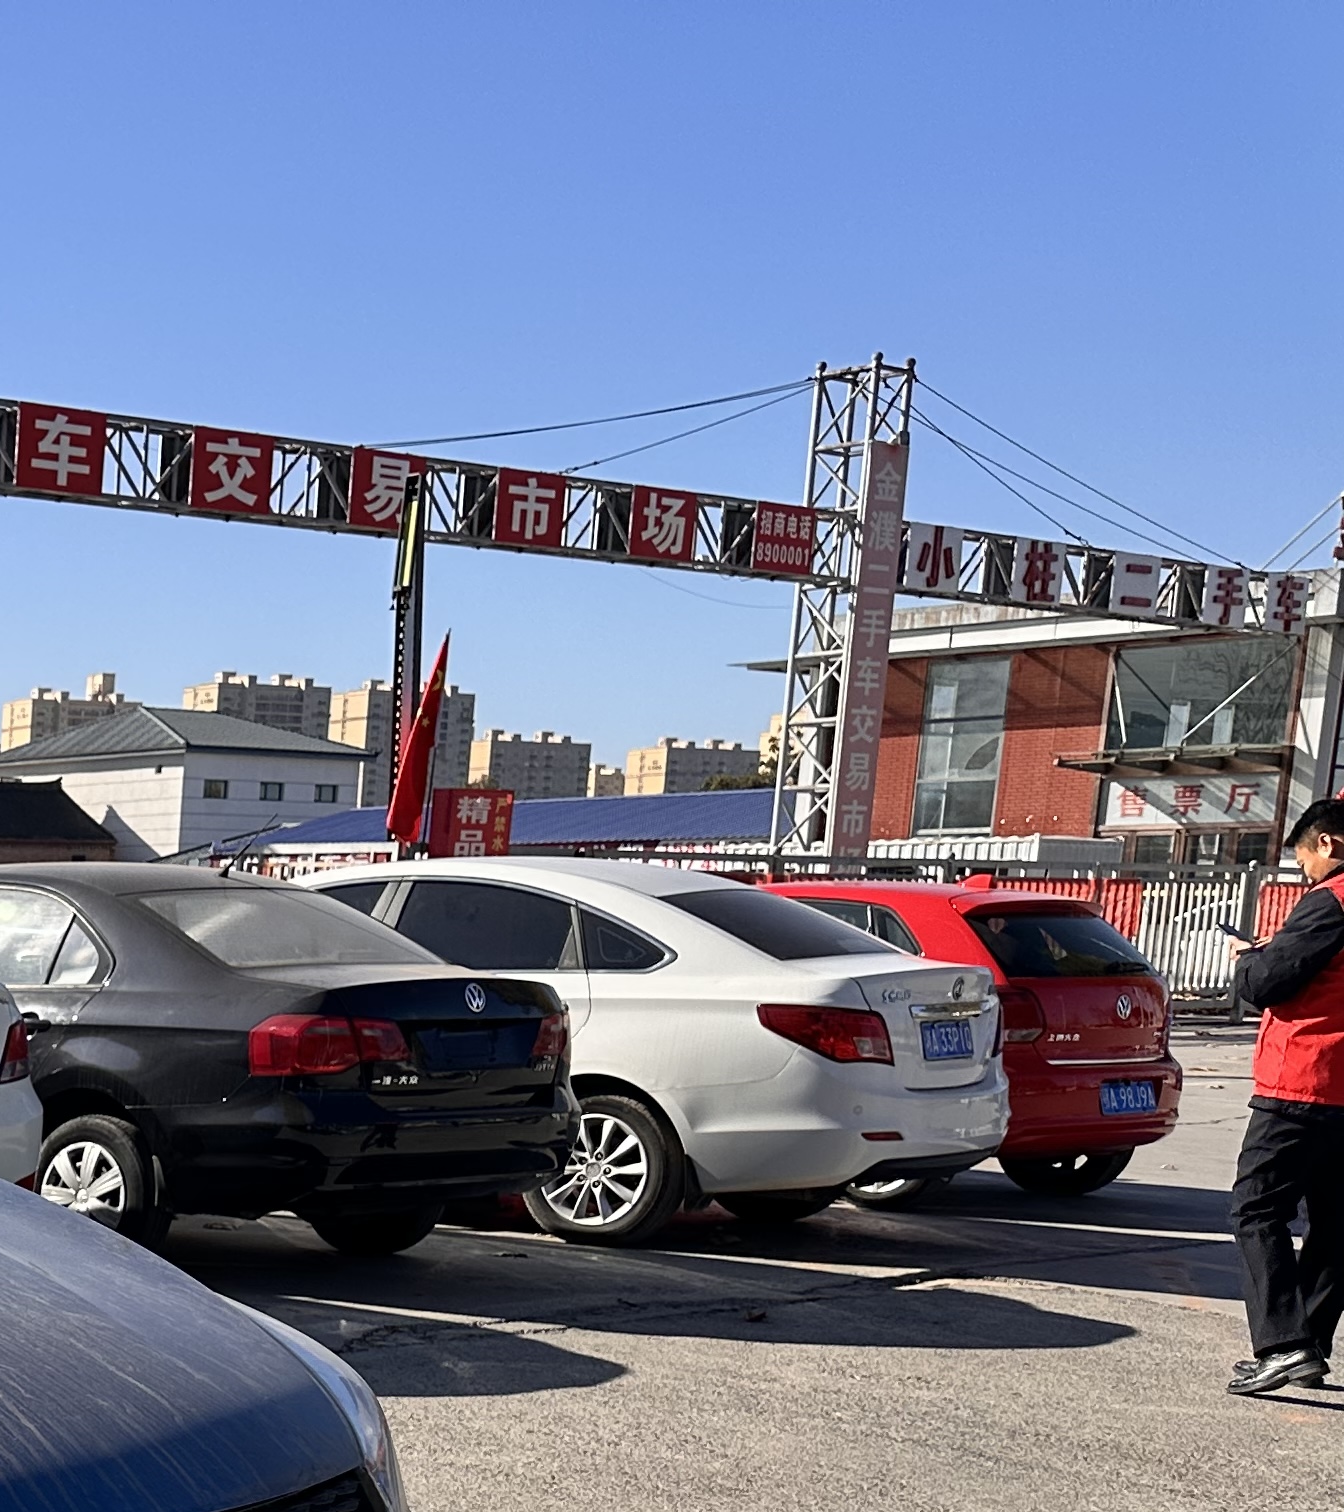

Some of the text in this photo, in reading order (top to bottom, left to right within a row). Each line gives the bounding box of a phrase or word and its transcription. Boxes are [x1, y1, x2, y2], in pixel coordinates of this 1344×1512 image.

[759, 509, 812, 541] 招商电话
[756, 541, 810, 567] 8900001
[1116, 783, 1261, 819] 售票厅
